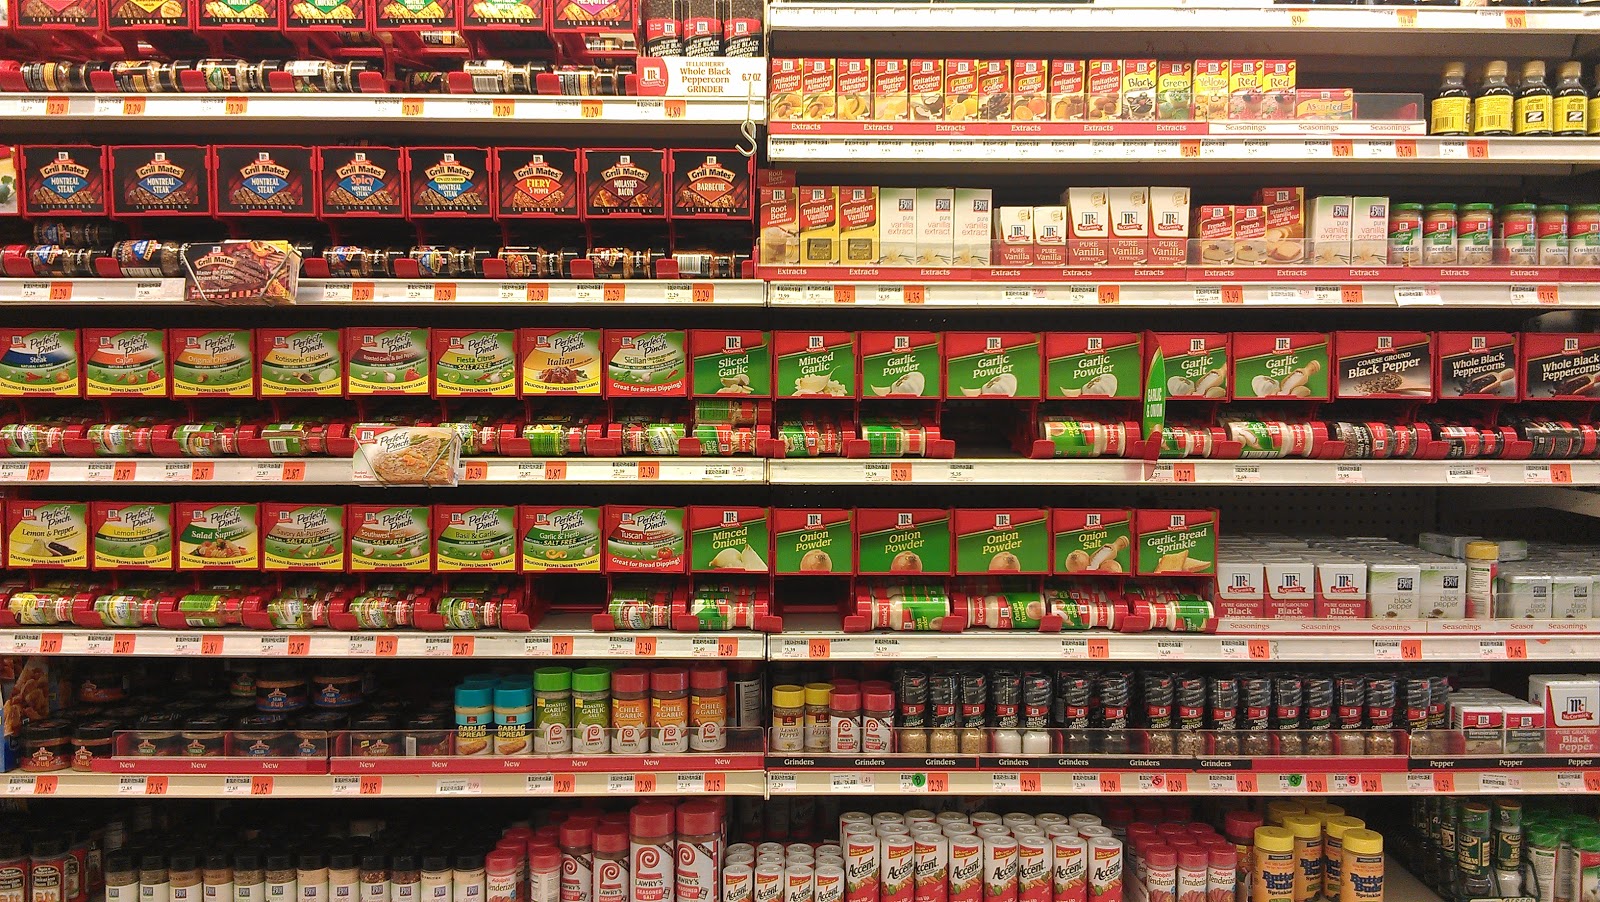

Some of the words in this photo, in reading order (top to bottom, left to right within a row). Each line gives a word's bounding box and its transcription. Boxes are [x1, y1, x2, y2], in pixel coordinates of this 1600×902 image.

[682, 76, 730, 85] Peppercorn
[1128, 78, 1153, 88] Black
[1162, 77, 1188, 89] Green
[1237, 76, 1257, 87] Red
[936, 124, 965, 132] Extracts
[1084, 124, 1114, 132] Extracts
[1226, 124, 1266, 132] Seasonings
[1370, 124, 1411, 132] Seasonings
[44, 165, 61, 176] Grill
[62, 166, 86, 176] Mates
[244, 166, 261, 176] Grill
[262, 166, 287, 176] Mates
[516, 168, 534, 178] Grill
[535, 168, 559, 178] Mates
[690, 169, 708, 180] Grill
[709, 168, 734, 178] Mates
[51, 177, 78, 186] MONTREAL
[147, 178, 174, 186] MONTREAL
[351, 175, 374, 186] Spicy
[526, 179, 551, 188] FIERY
[613, 180, 638, 188] MOLASSES
[617, 188, 634, 196] BACON
[696, 183, 726, 192] BARBECUE
[771, 205, 787, 213] Root
[803, 205, 832, 214] Imitation
[807, 212, 829, 220] Vanilla
[1073, 248, 1104, 256] Vanilla
[1112, 246, 1144, 256] Vanilla
[198, 256, 216, 266] Grill
[217, 256, 234, 265] Mates
[778, 268, 806, 276] Extracts
[30, 332, 58, 349] Perfect
[292, 331, 320, 347] Perfect
[30, 356, 47, 364] Steak
[275, 355, 302, 364] Rotisserie
[302, 352, 329, 362] Chicken
[457, 355, 475, 364] Fiesta
[476, 354, 495, 363] Citrus
[547, 357, 575, 366] Italian
[625, 356, 646, 364] Sicilian
[719, 356, 749, 368] Sliced
[799, 352, 834, 368] Minced
[888, 355, 916, 368] Garlic
[1079, 356, 1110, 368] Garlic
[1358, 356, 1383, 366] COARSE
[1384, 352, 1411, 362] GROUND
[1453, 359, 1480, 370] Whole
[1480, 353, 1504, 364] Black
[801, 362, 831, 374] Garlic
[1181, 357, 1213, 370] Garlic
[1348, 362, 1379, 378] Black
[1382, 357, 1420, 374] Pepper
[718, 366, 748, 376] Garlic
[883, 363, 920, 376] Powder
[1074, 364, 1114, 379] Powder
[1186, 366, 1206, 378] Salt
[1453, 362, 1506, 378] Peppercorns
[658, 381, 682, 392] Dipping!
[22, 528, 44, 538] Lemon
[52, 526, 74, 537] Pepper
[192, 530, 212, 540] Salad
[540, 532, 556, 540] Garlic
[563, 531, 579, 539] Herb
[621, 531, 643, 539] Tuscan
[713, 526, 747, 541] Minced
[800, 531, 829, 543] Onion
[1079, 531, 1107, 542] Onion
[987, 532, 1018, 545] Onion
[1147, 534, 1177, 547] Garlic
[1179, 528, 1207, 541] Bread
[713, 537, 747, 549] Onions
[796, 538, 832, 552] Powder
[983, 539, 1022, 554] Powder
[1083, 540, 1101, 550] Salt
[1157, 539, 1196, 554] Sprinkle
[1230, 622, 1269, 630] Seasonings
[1563, 735, 1590, 743] Black
[1559, 743, 1593, 753] Pepper
[572, 759, 588, 767] New
[784, 758, 814, 766] Grinders
[925, 758, 956, 766] Grinders
[1058, 758, 1088, 766] Grinders
[1201, 760, 1231, 768] Grinders
[1430, 760, 1454, 768] Pepper
[1499, 759, 1523, 767] Pepper
[1568, 758, 1592, 767] Pepper
[634, 879, 663, 887] LAWRY'S
